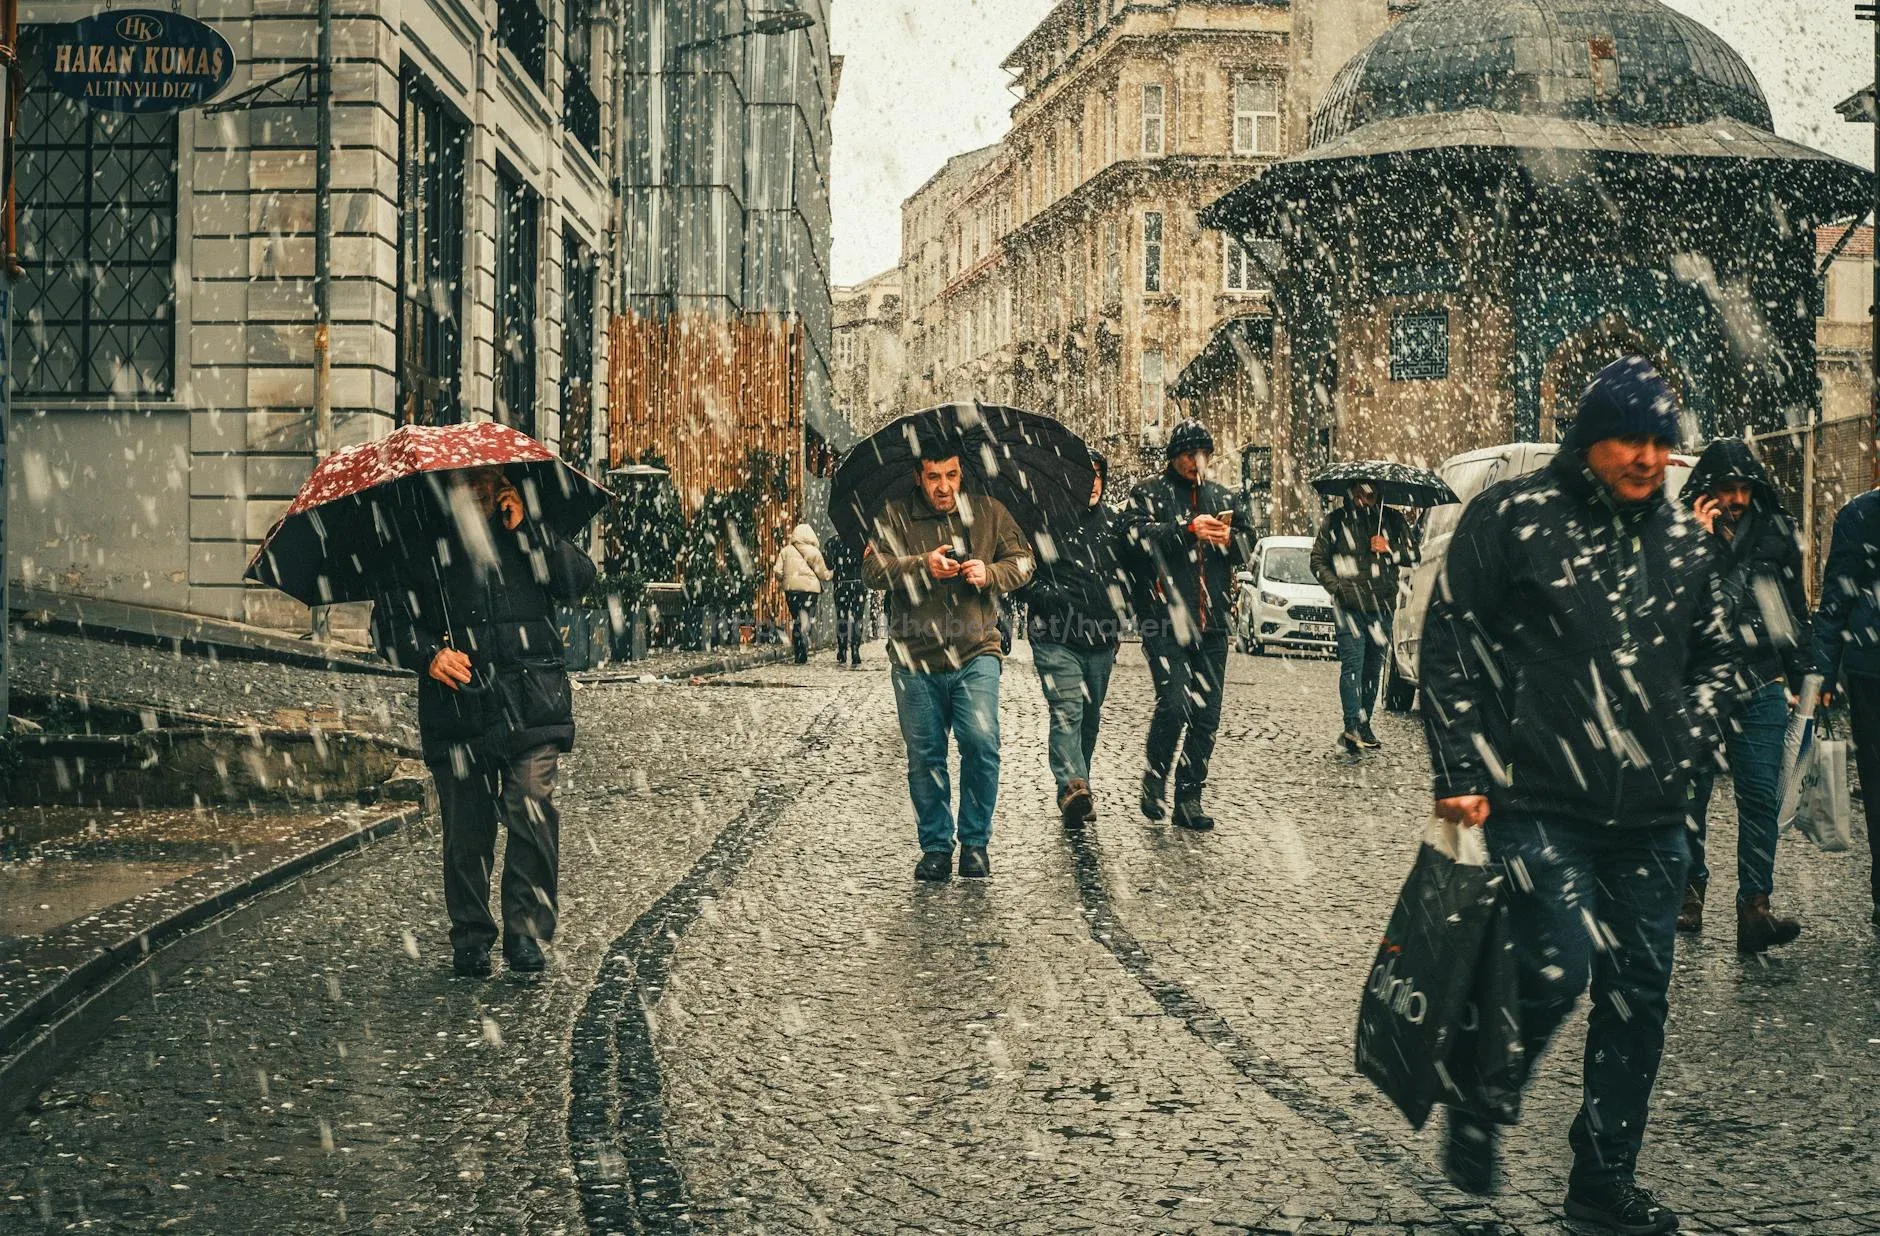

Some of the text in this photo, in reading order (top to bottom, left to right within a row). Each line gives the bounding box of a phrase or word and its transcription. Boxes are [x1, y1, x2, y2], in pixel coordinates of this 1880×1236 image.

[123, 16, 153, 41] HK
[54, 45, 224, 82] HAKAN KUMAŞ
[83, 80, 191, 98] ALTINYILDIZ
